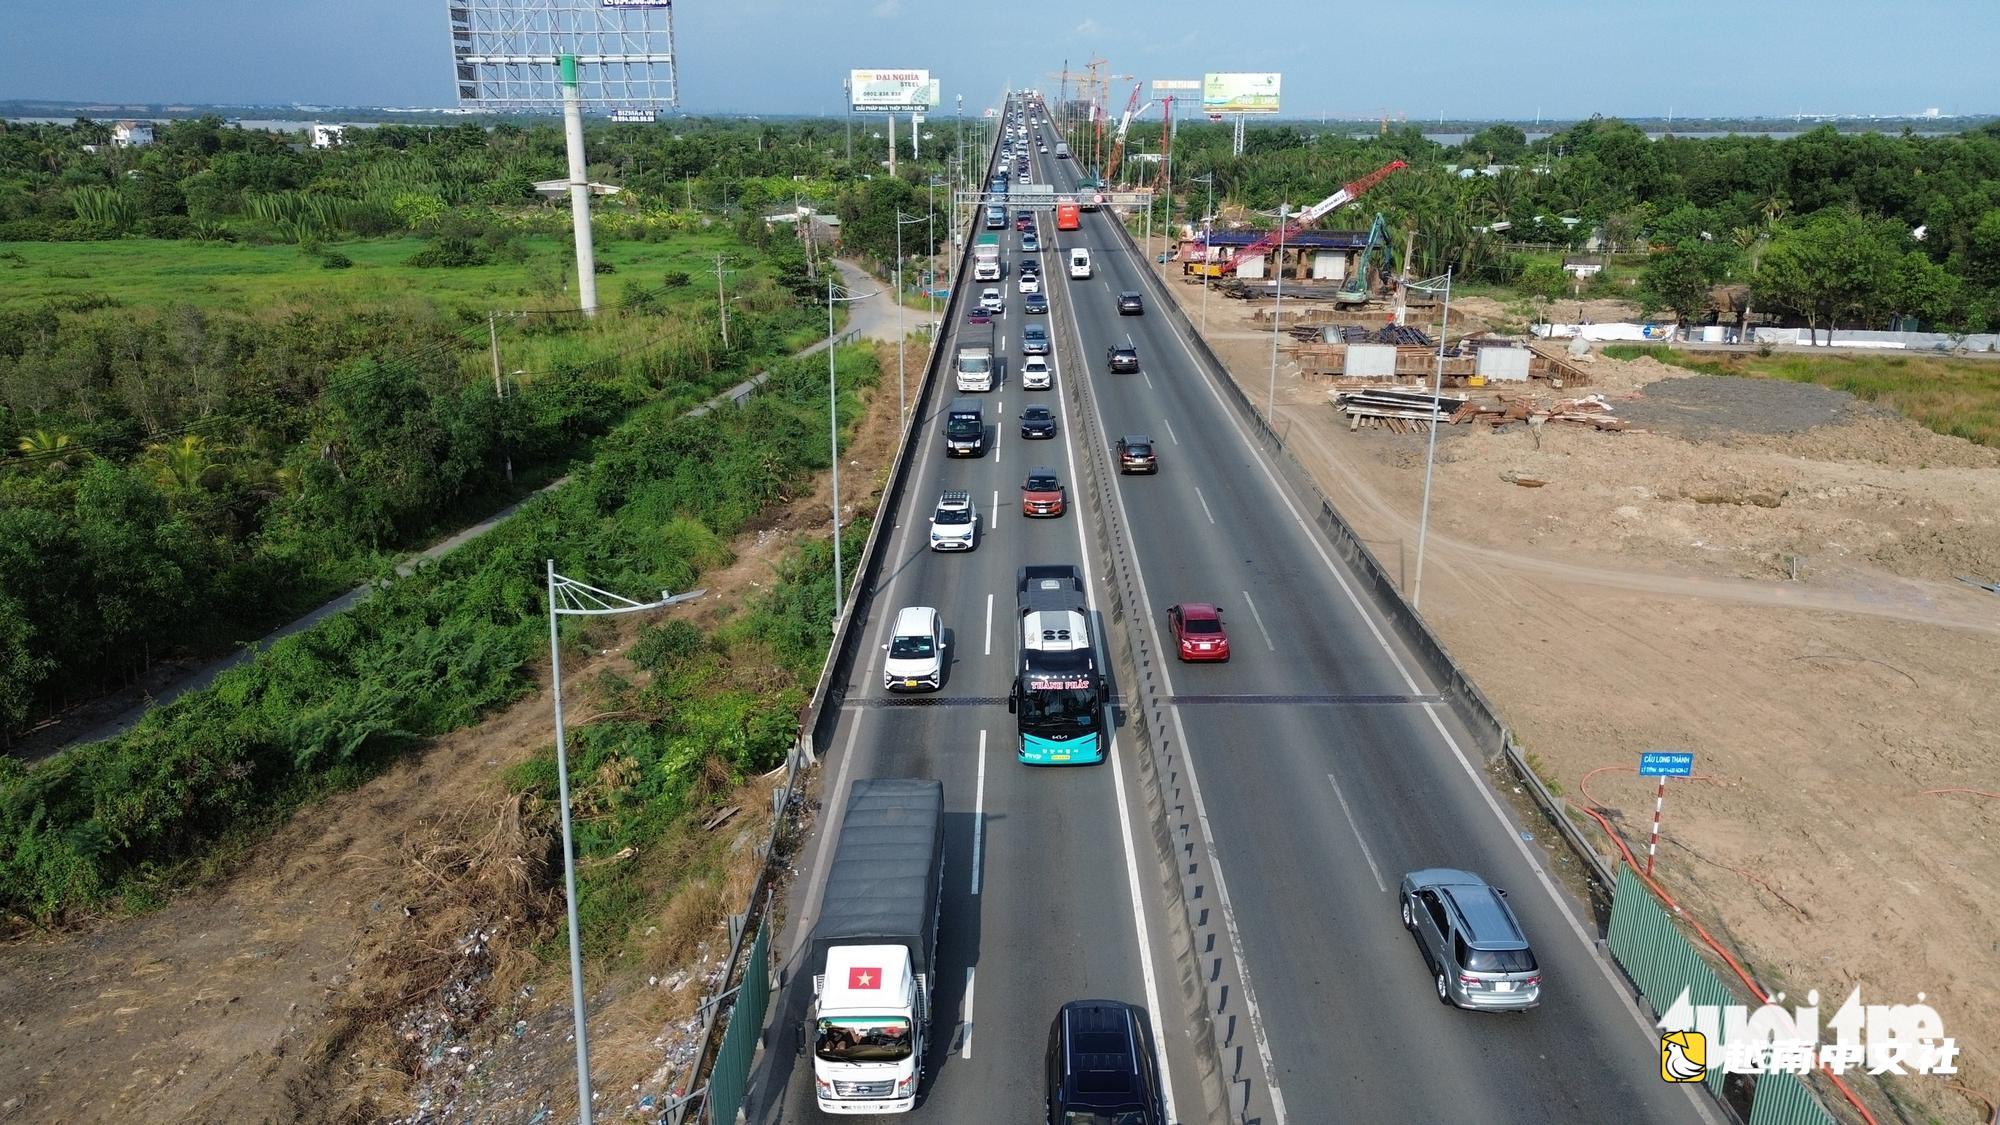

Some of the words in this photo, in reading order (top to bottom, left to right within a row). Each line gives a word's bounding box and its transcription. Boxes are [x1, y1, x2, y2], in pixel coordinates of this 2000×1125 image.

[1031, 680, 1063, 690] THÀNH
[1065, 679, 1089, 689] PHÁT
[1671, 755, 1690, 763] THÀNH
